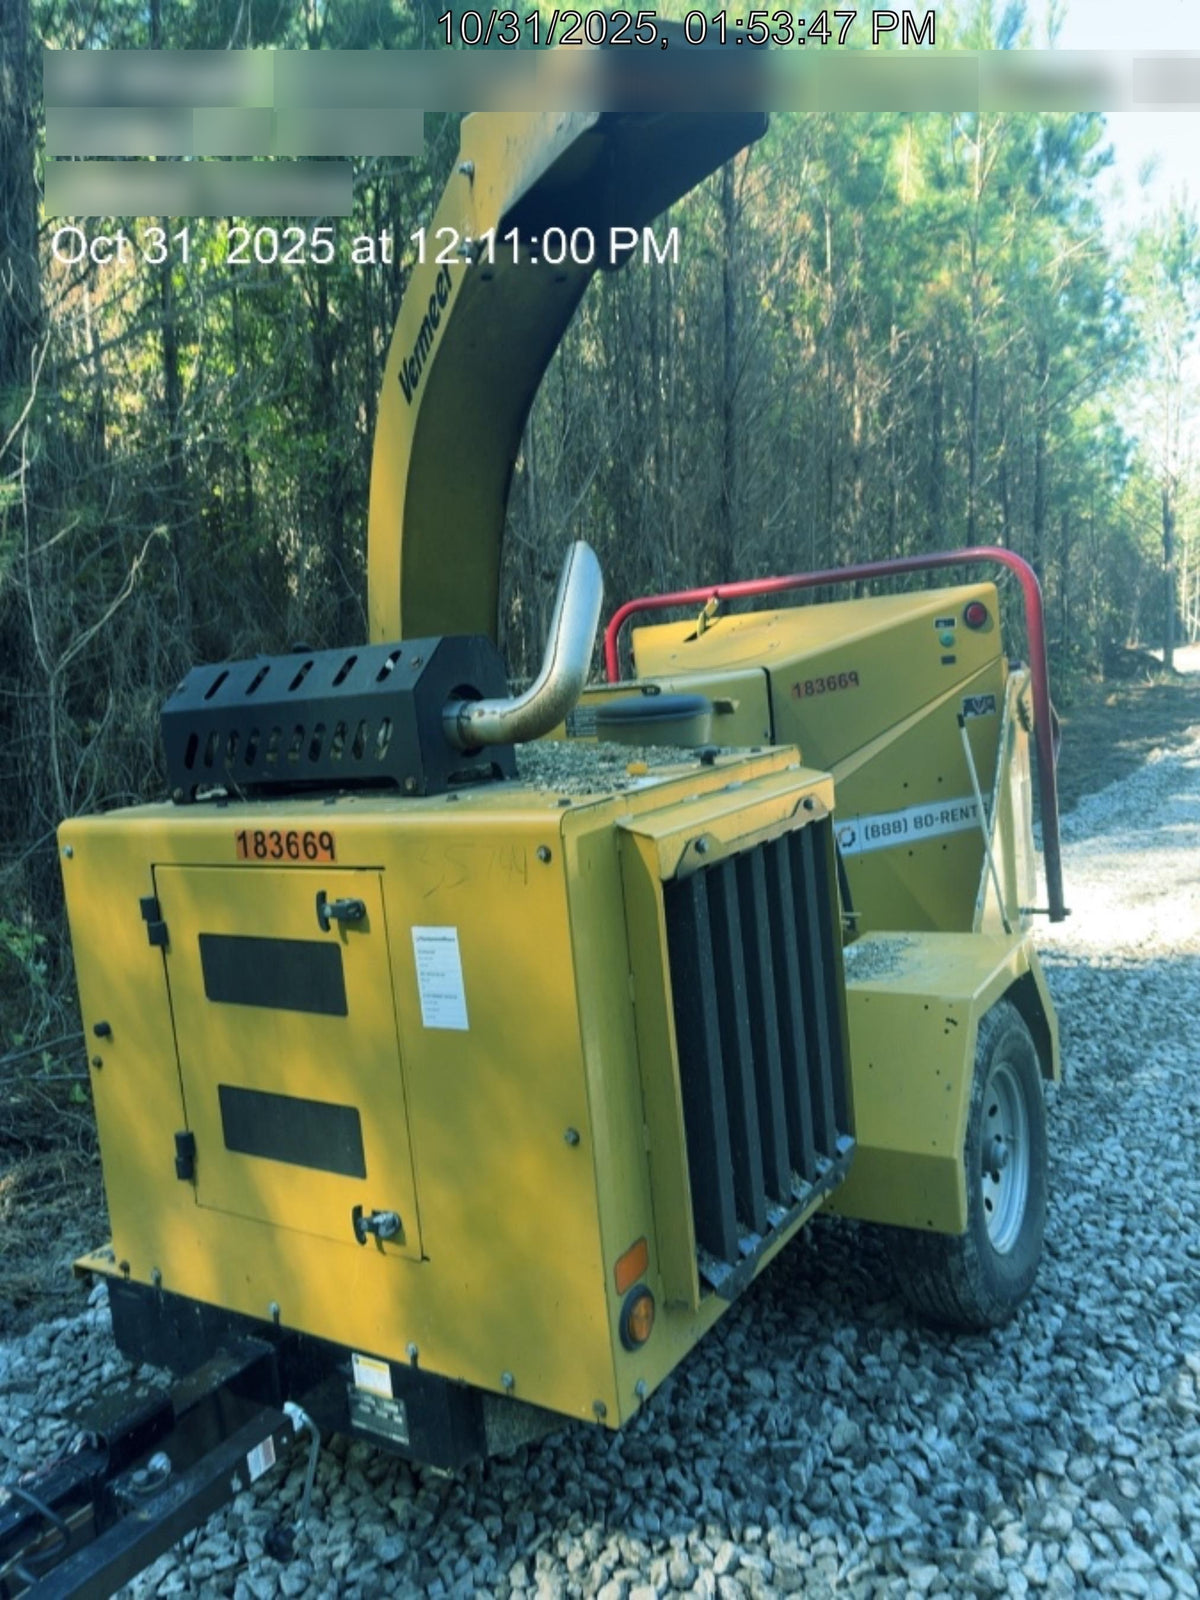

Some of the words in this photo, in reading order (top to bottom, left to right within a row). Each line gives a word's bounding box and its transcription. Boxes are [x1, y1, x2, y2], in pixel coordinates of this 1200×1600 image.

[397, 243, 453, 405] Vermeer
[793, 671, 860, 698] 183669
[864, 818, 908, 841] (888)
[237, 829, 336, 861] 183669
